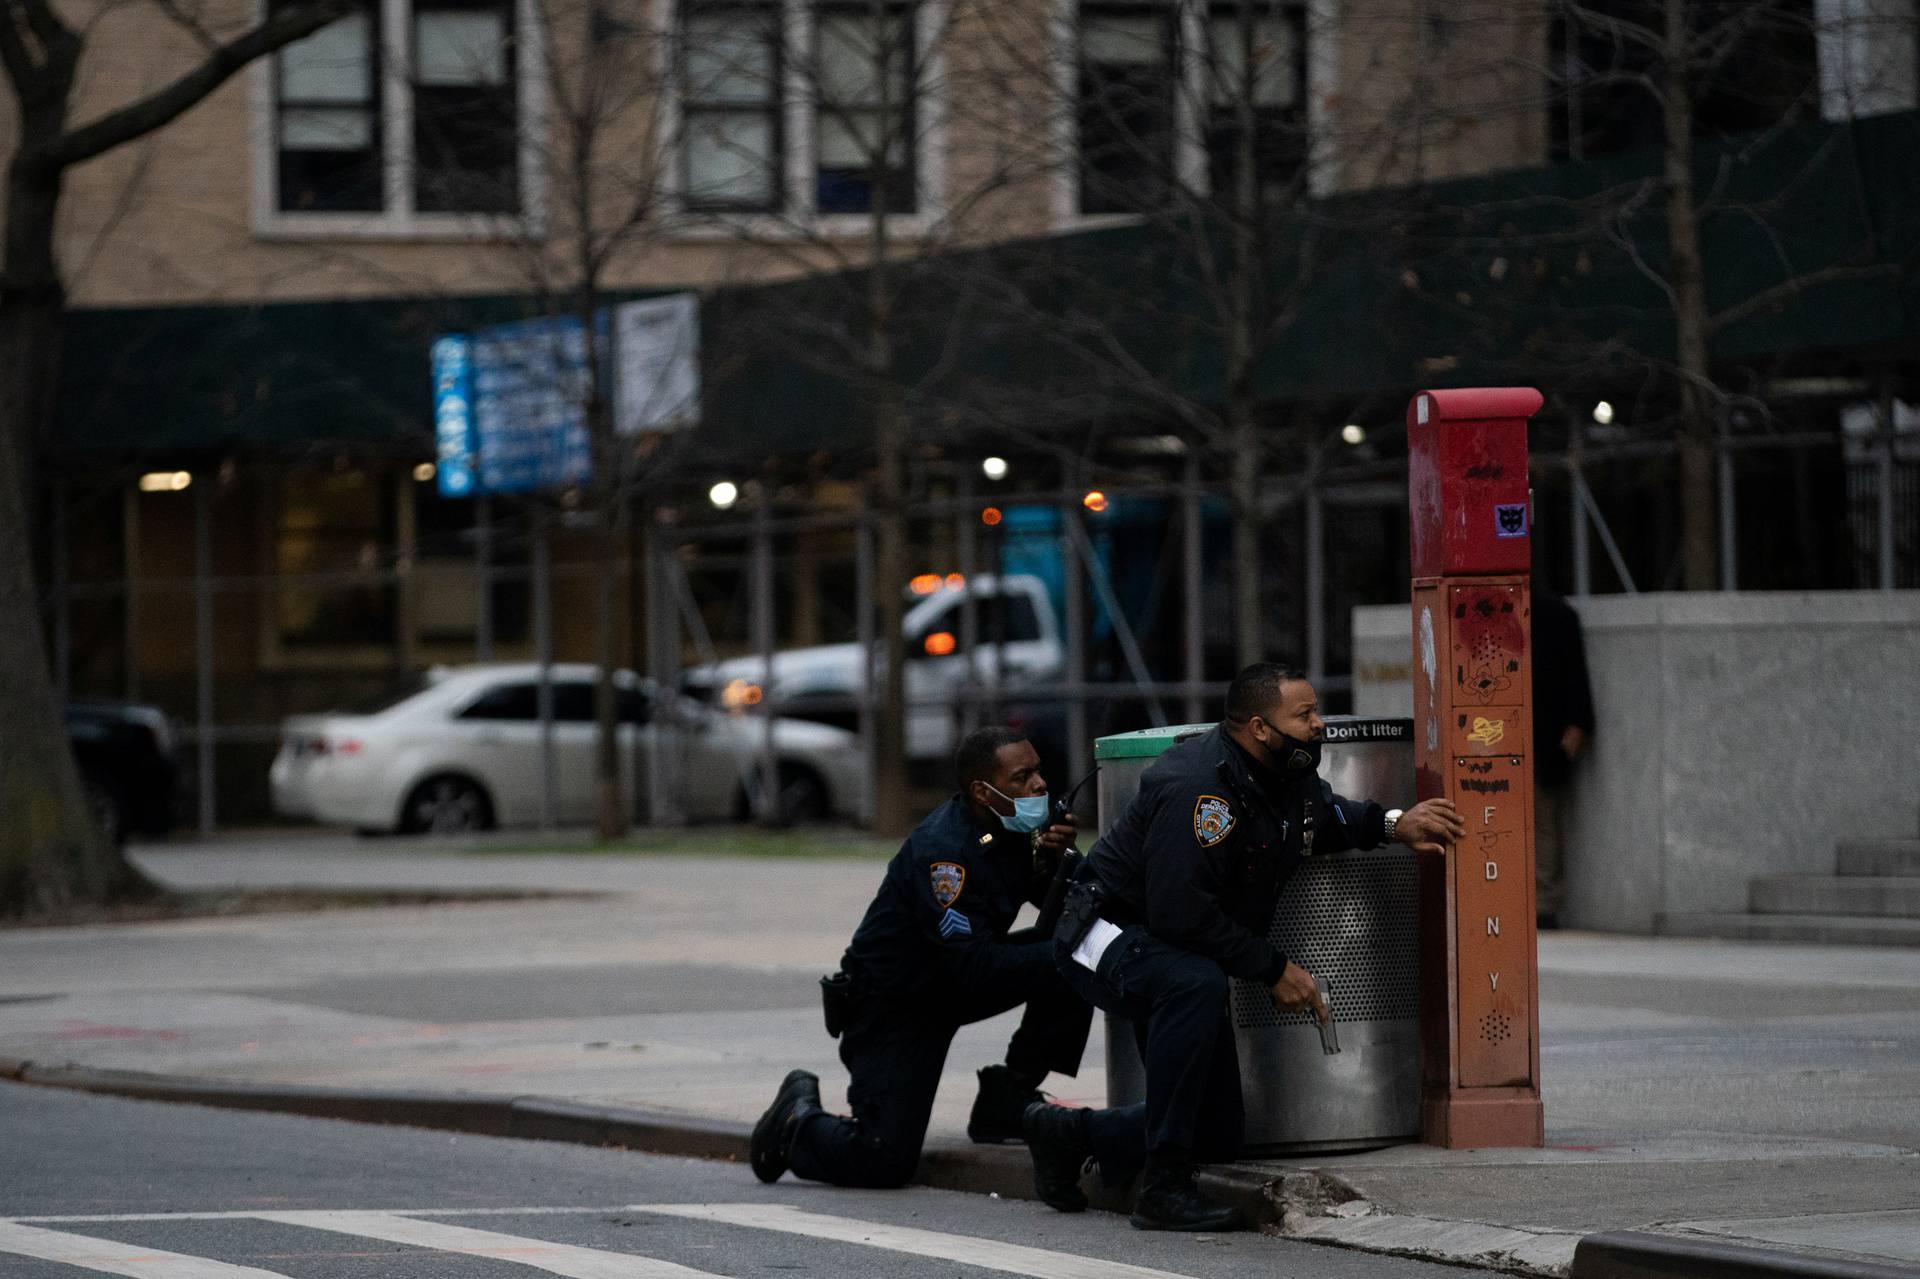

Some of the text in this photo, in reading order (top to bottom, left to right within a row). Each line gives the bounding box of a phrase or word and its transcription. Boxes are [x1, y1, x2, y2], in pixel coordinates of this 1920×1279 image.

[1326, 724, 1403, 738] Don't litter
[1210, 799, 1229, 812] POLICE
